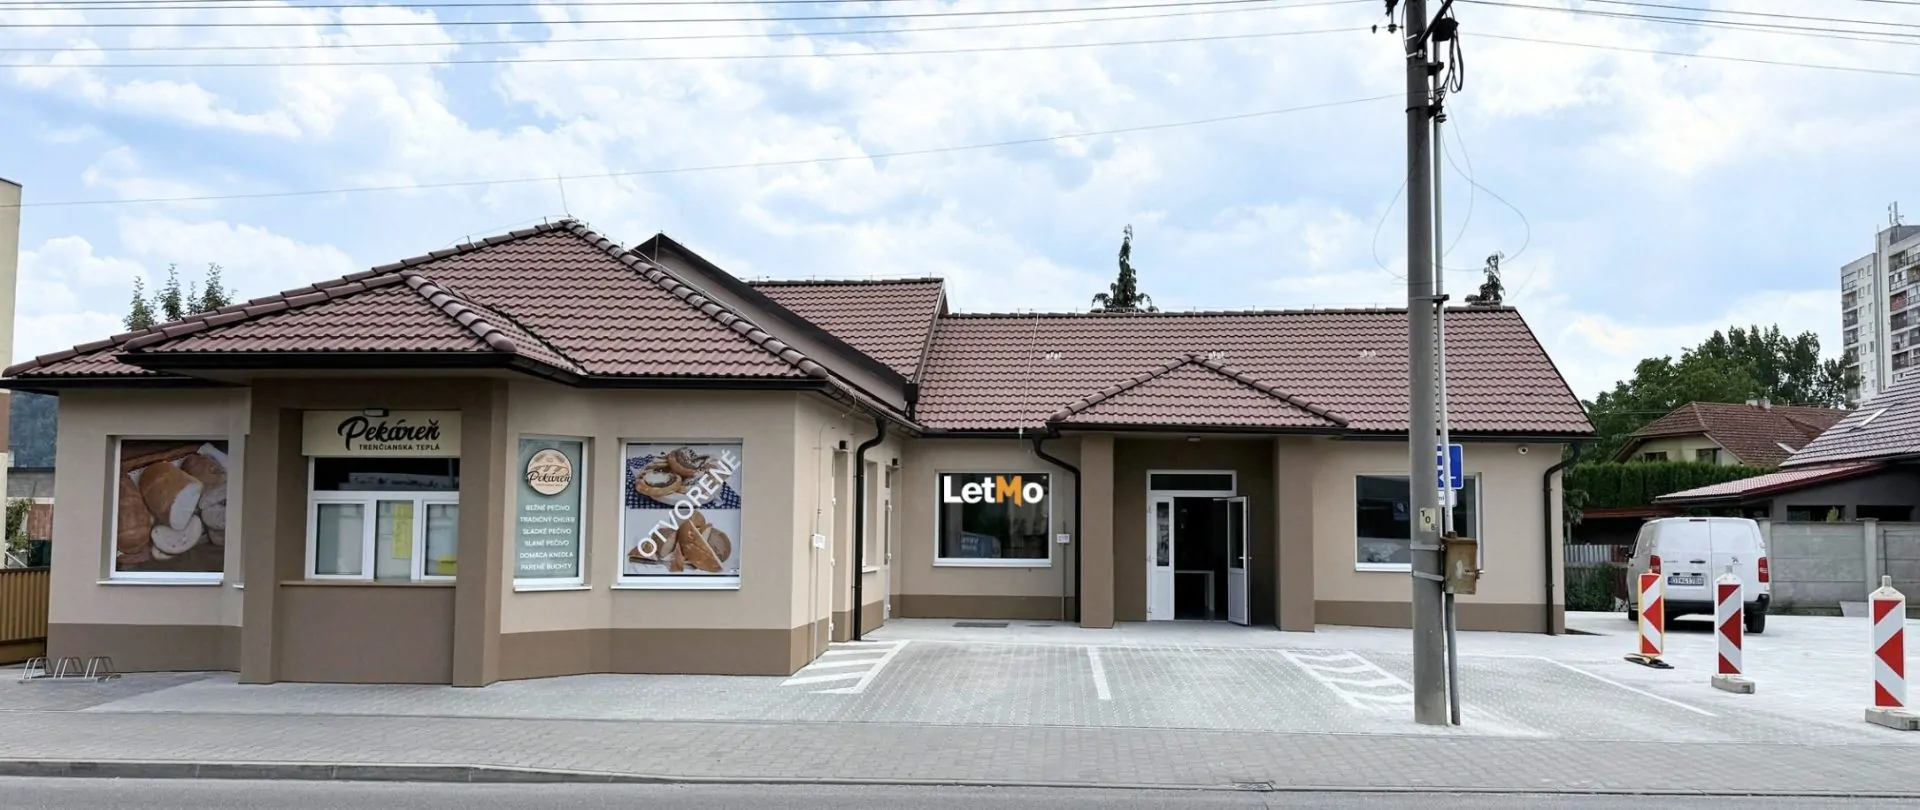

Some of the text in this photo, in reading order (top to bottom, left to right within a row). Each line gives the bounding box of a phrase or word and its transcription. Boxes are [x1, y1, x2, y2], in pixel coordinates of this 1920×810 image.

[337, 416, 440, 451] Pekáreň
[359, 443, 440, 451] TRENČIANSKA TEPLÁ
[943, 475, 1044, 508] LetMo
[637, 449, 741, 557] OTVORENÉ
[520, 515, 552, 523] TRADIČNÝ
[546, 539, 570, 547] PEČIVO
[520, 551, 547, 559] DOMÁCA
[547, 562, 573, 570] BUCHTY
